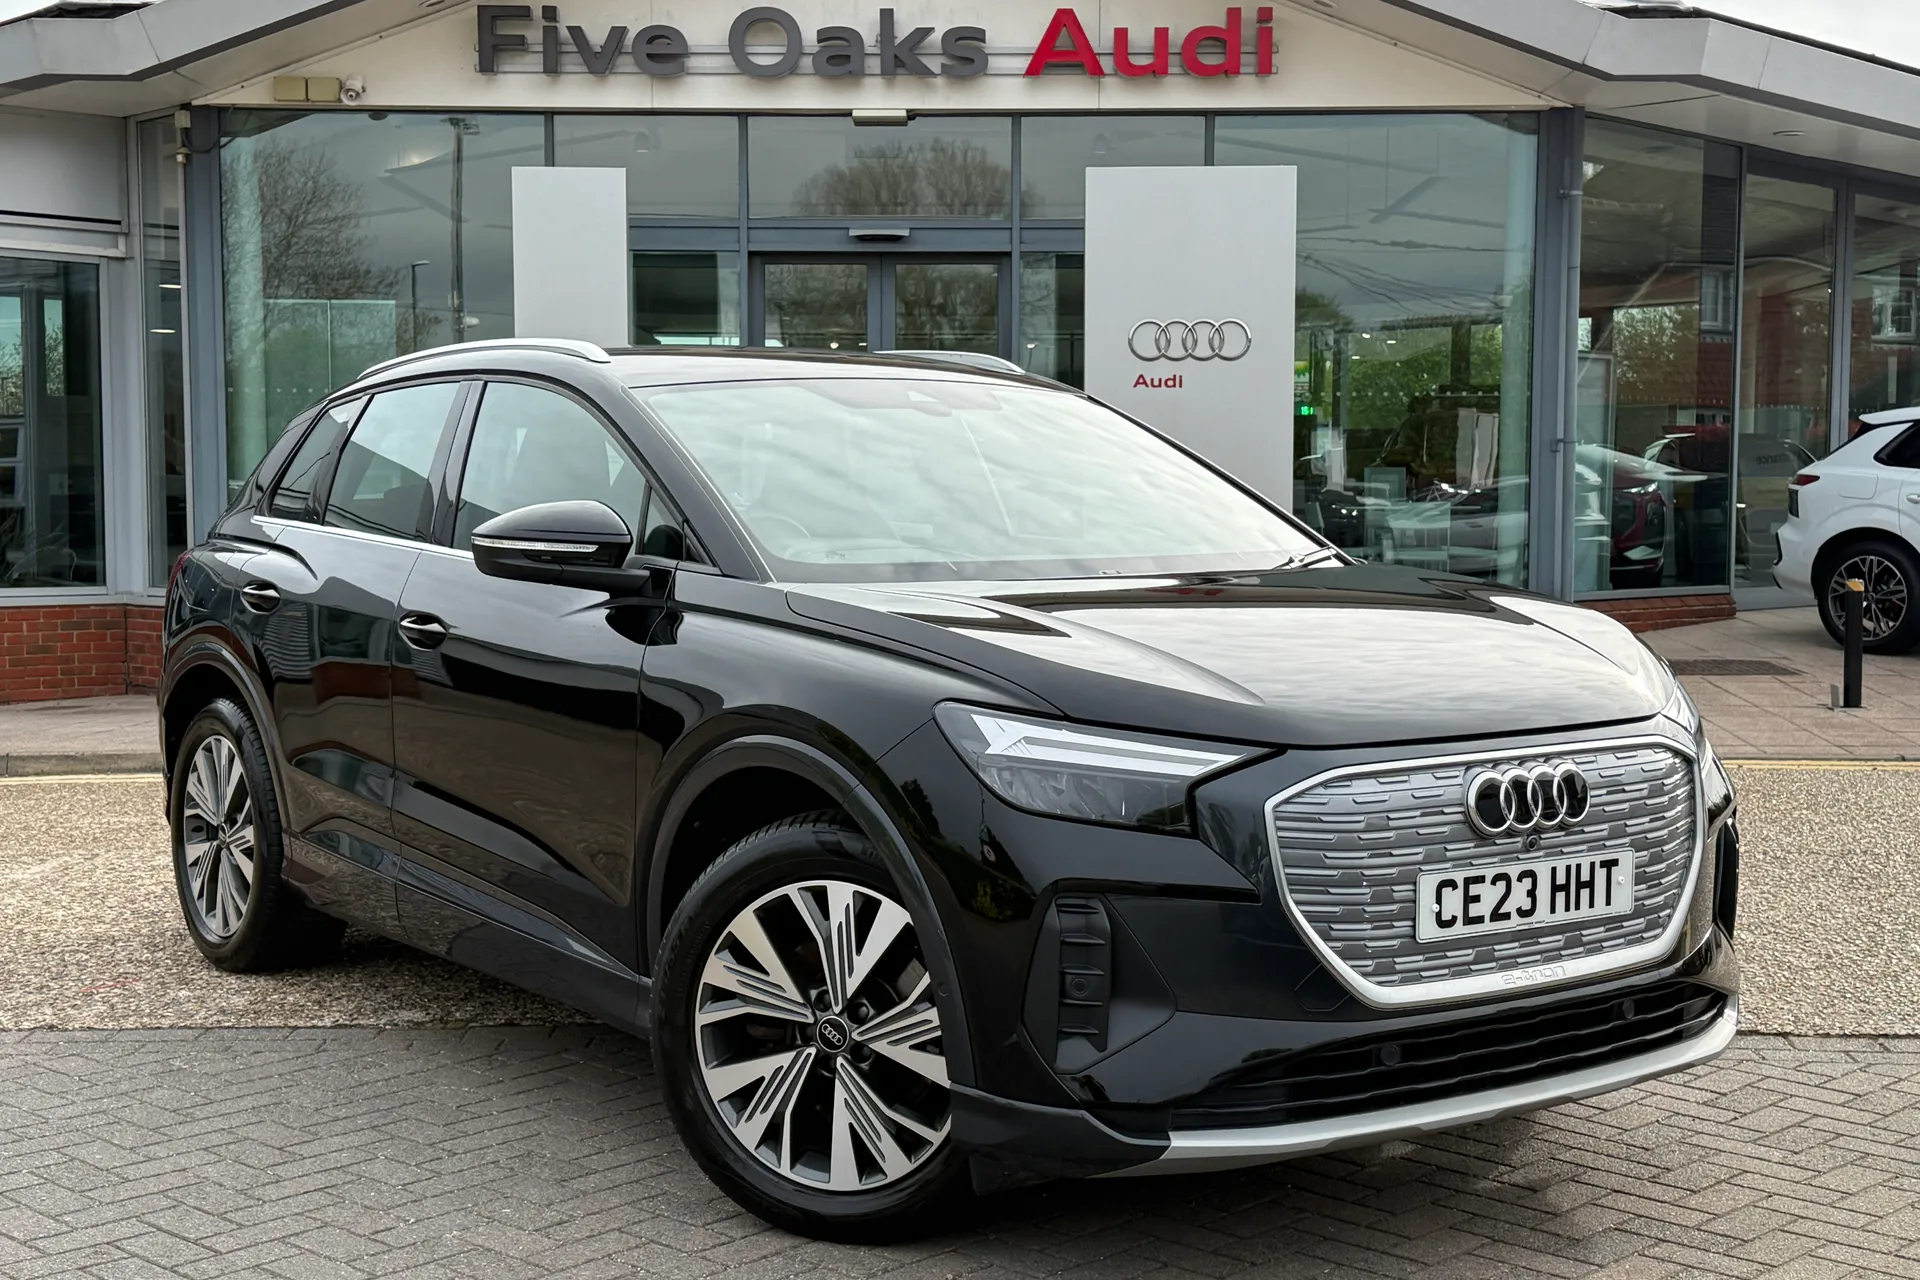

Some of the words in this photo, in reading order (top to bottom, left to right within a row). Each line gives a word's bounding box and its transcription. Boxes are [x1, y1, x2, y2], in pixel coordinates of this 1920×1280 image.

[477, 4, 690, 77] Five
[728, 6, 989, 78] Oaks
[1023, 6, 1273, 77] Audi
[1133, 373, 1183, 388] Audi
[1435, 869, 1538, 929] CE23
[1550, 858, 1619, 915] HHT
[1501, 965, 1567, 985] e-tron
